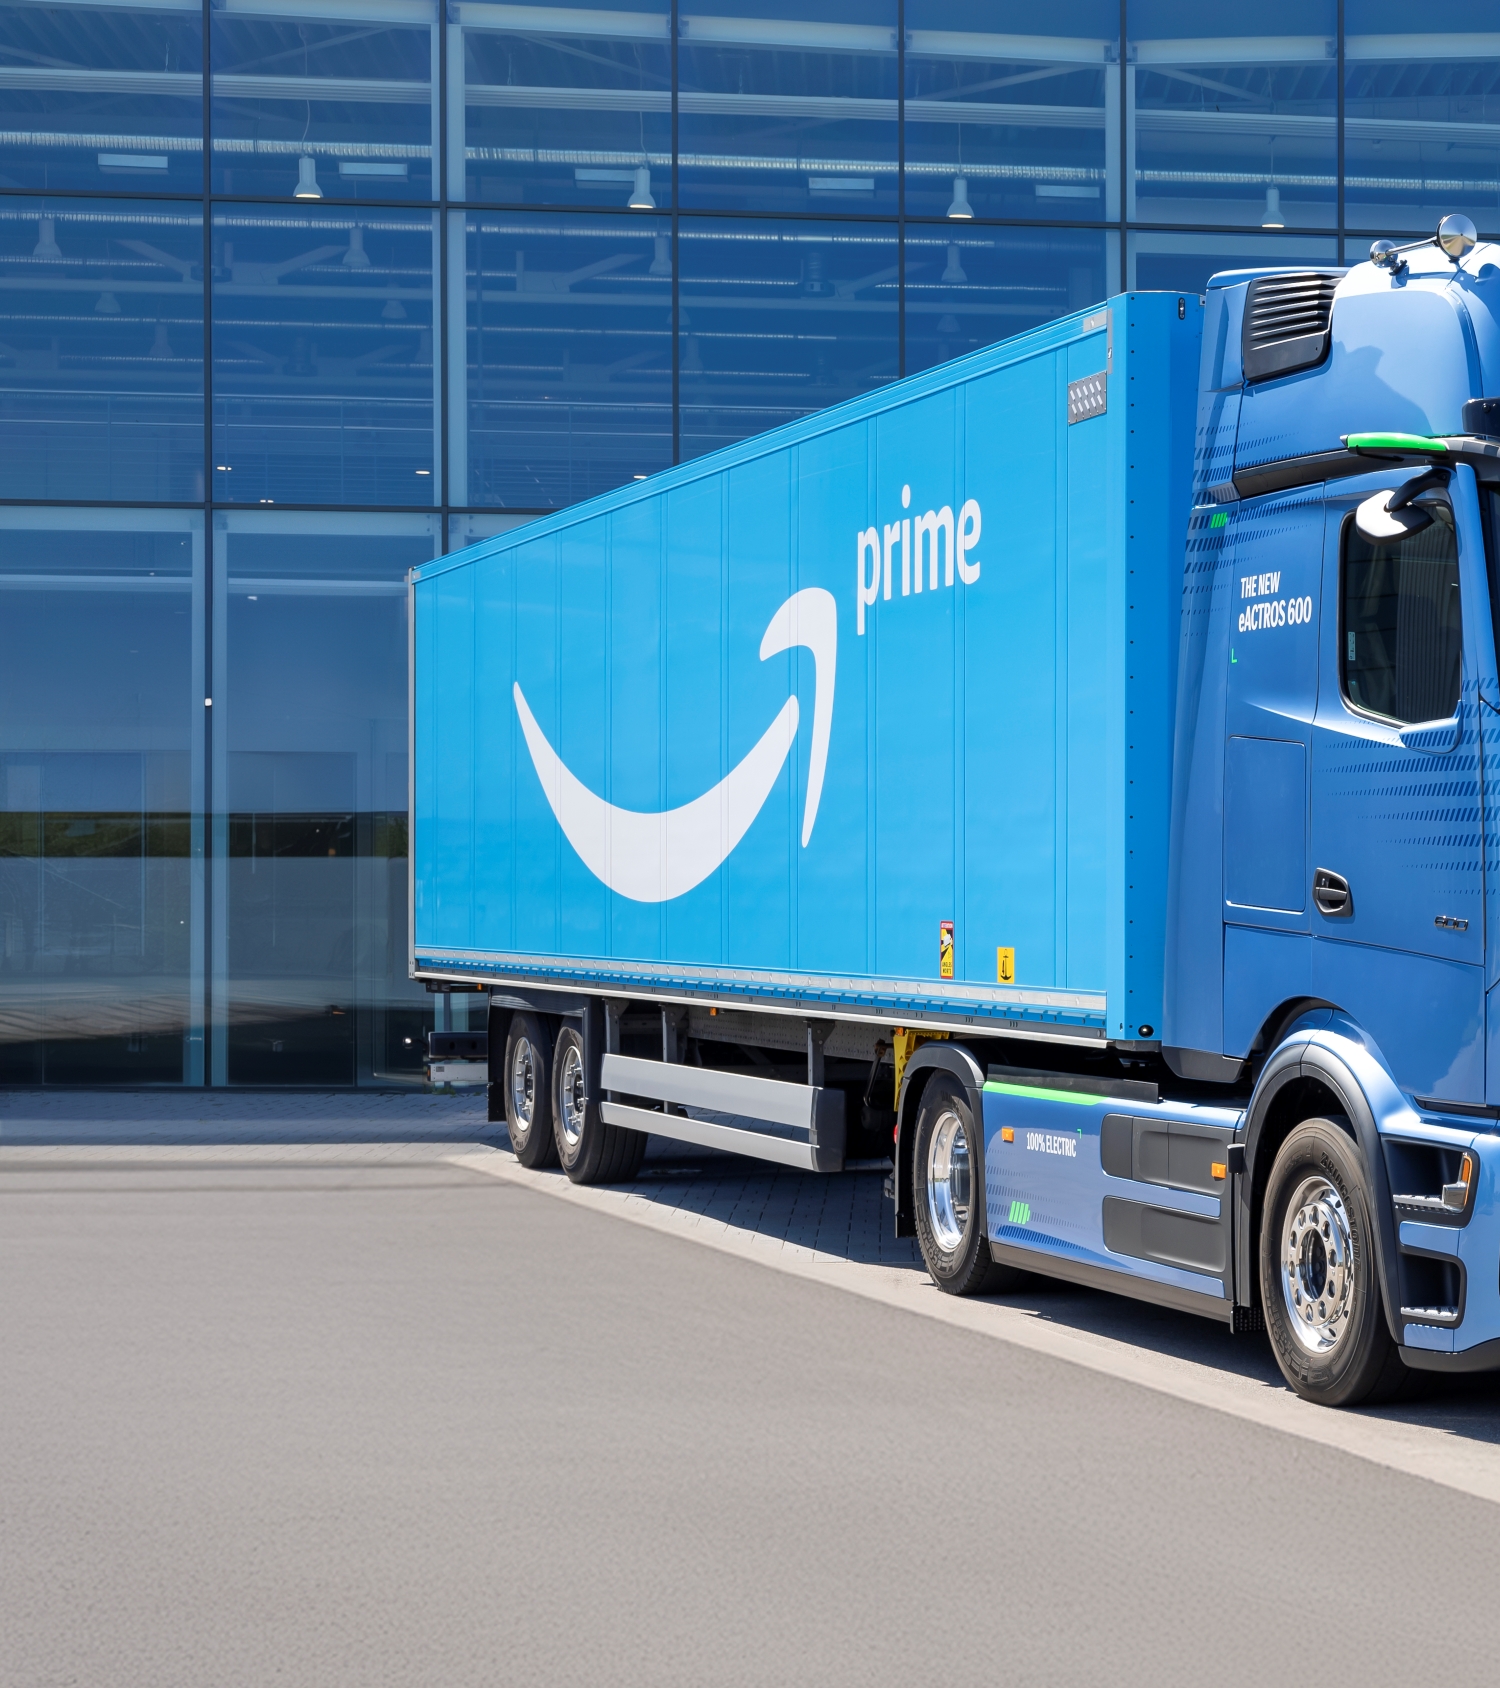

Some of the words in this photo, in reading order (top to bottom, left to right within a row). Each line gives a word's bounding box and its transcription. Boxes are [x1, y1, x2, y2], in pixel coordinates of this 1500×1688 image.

[857, 484, 982, 636] prime
[1240, 575, 1257, 599] THE
[1258, 571, 1281, 596] NEW
[1238, 599, 1286, 633] eACTROS
[1287, 596, 1312, 626] 600
[1026, 1131, 1046, 1153] 100%
[1045, 1134, 1077, 1158] ELECTRIC
